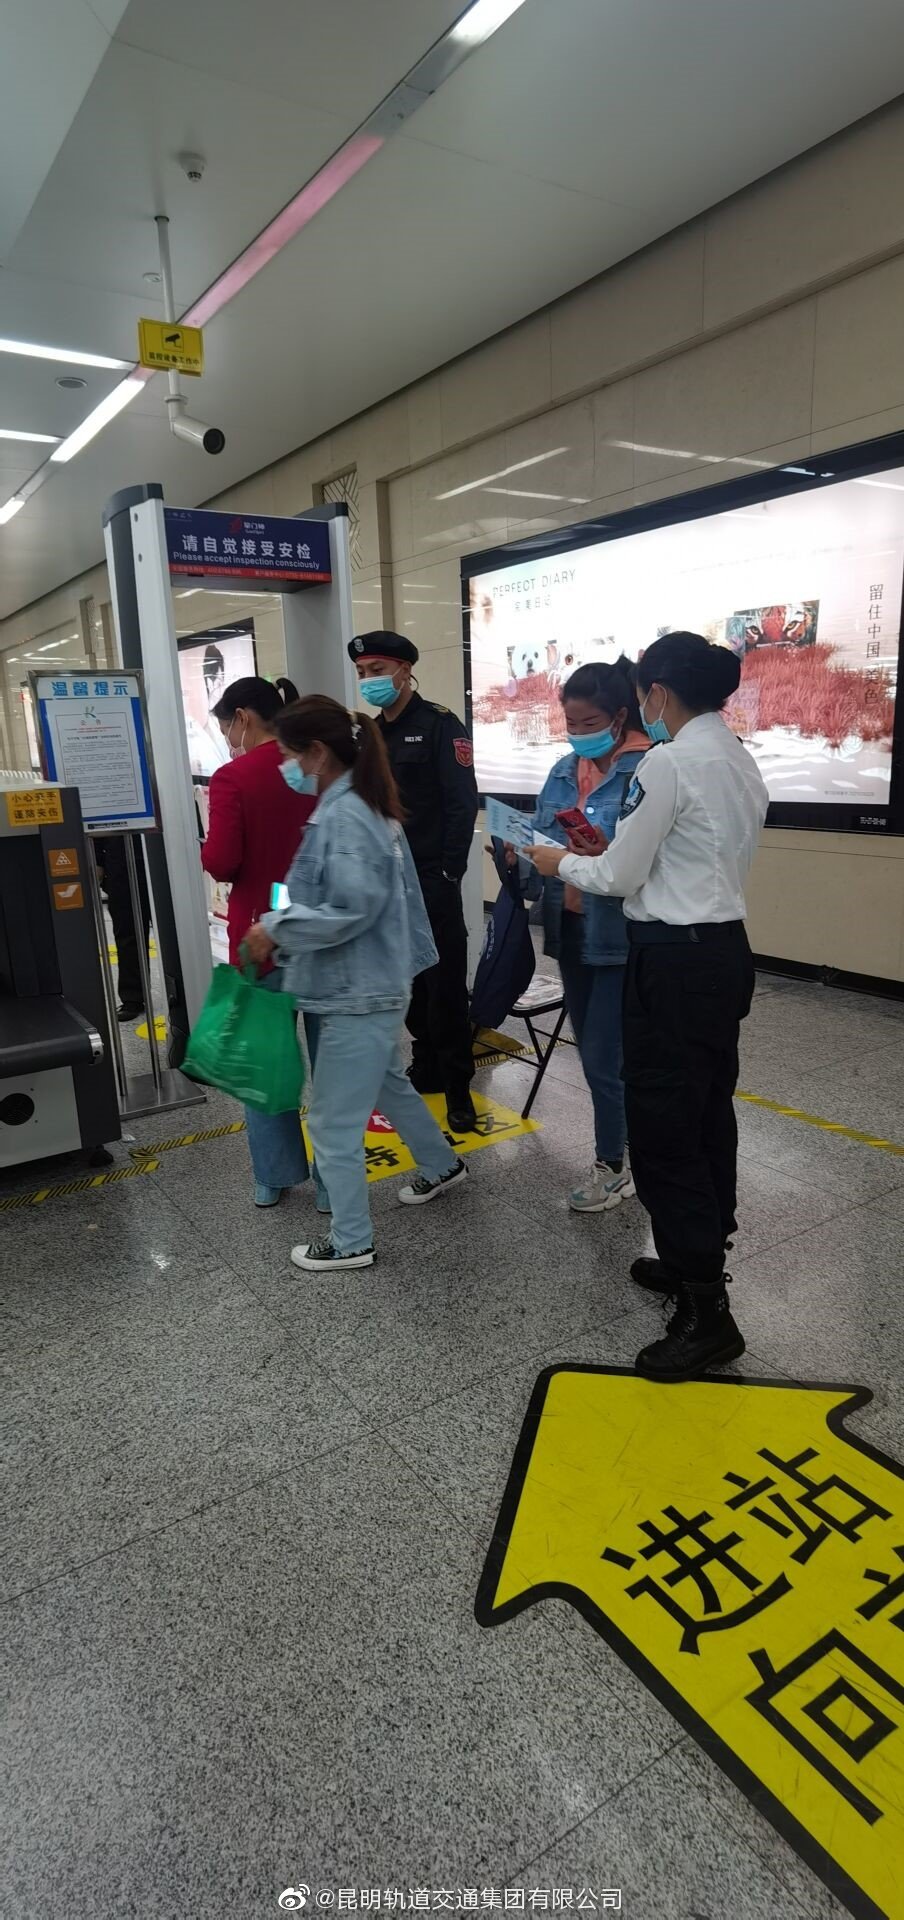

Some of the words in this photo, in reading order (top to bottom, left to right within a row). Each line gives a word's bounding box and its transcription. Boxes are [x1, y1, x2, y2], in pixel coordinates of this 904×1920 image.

[182, 534, 311, 560] 请自觉接受安检
[173, 551, 203, 561] Please
[204, 554, 232, 563] accept
[233, 556, 275, 566] inspection
[275, 559, 320, 570] consciously
[542, 568, 576, 588] DIARY
[51, 681, 129, 697] 温馨提示
[600, 1447, 893, 1656] 进站
